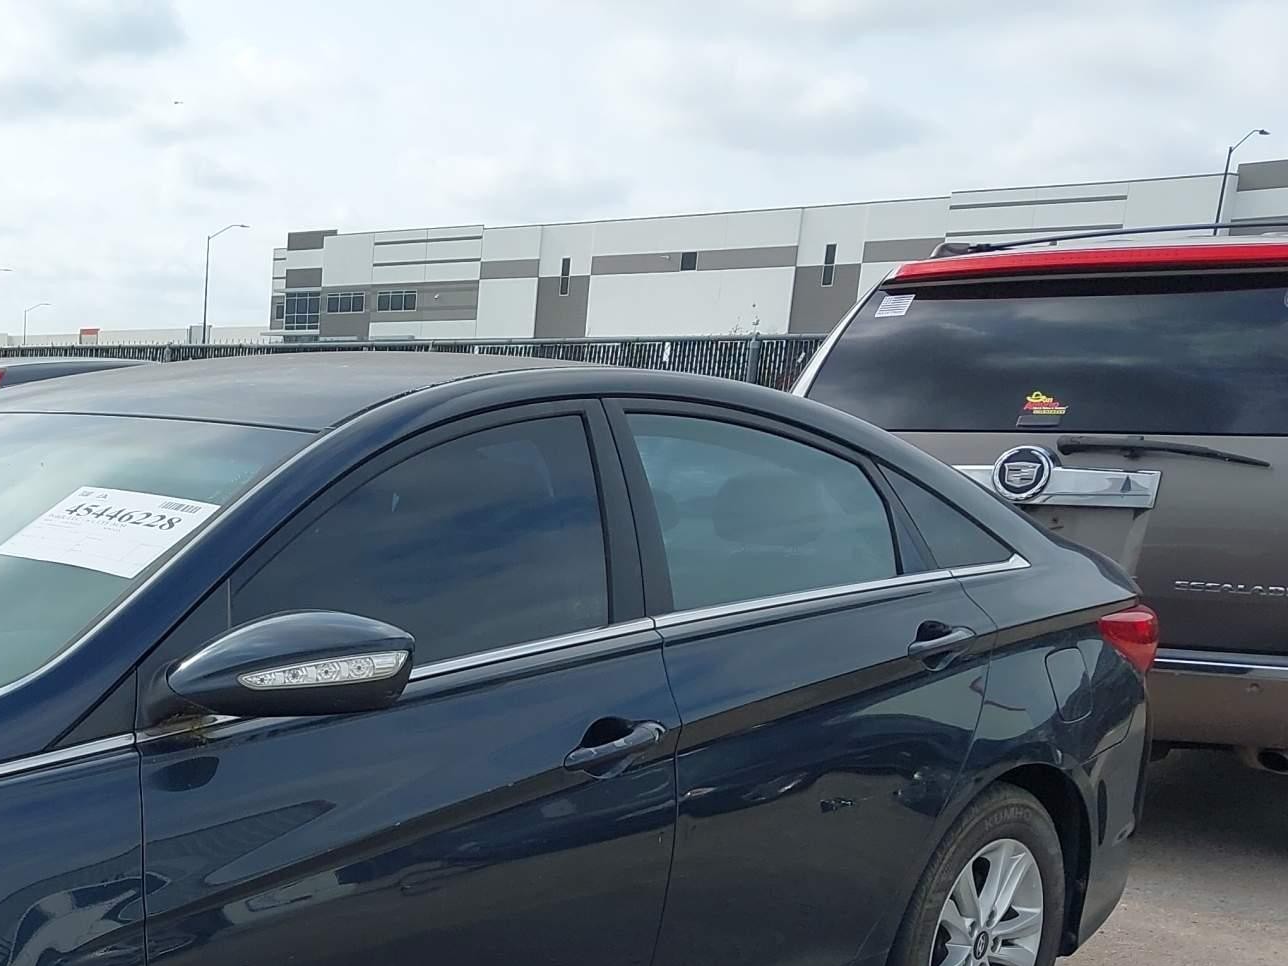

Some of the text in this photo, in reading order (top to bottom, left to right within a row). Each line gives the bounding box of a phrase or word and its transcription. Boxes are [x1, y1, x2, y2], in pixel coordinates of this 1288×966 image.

[65, 502, 182, 531] 45446228
[1174, 580, 1288, 597] ESCALAD
[983, 806, 1034, 832] KUMHO
